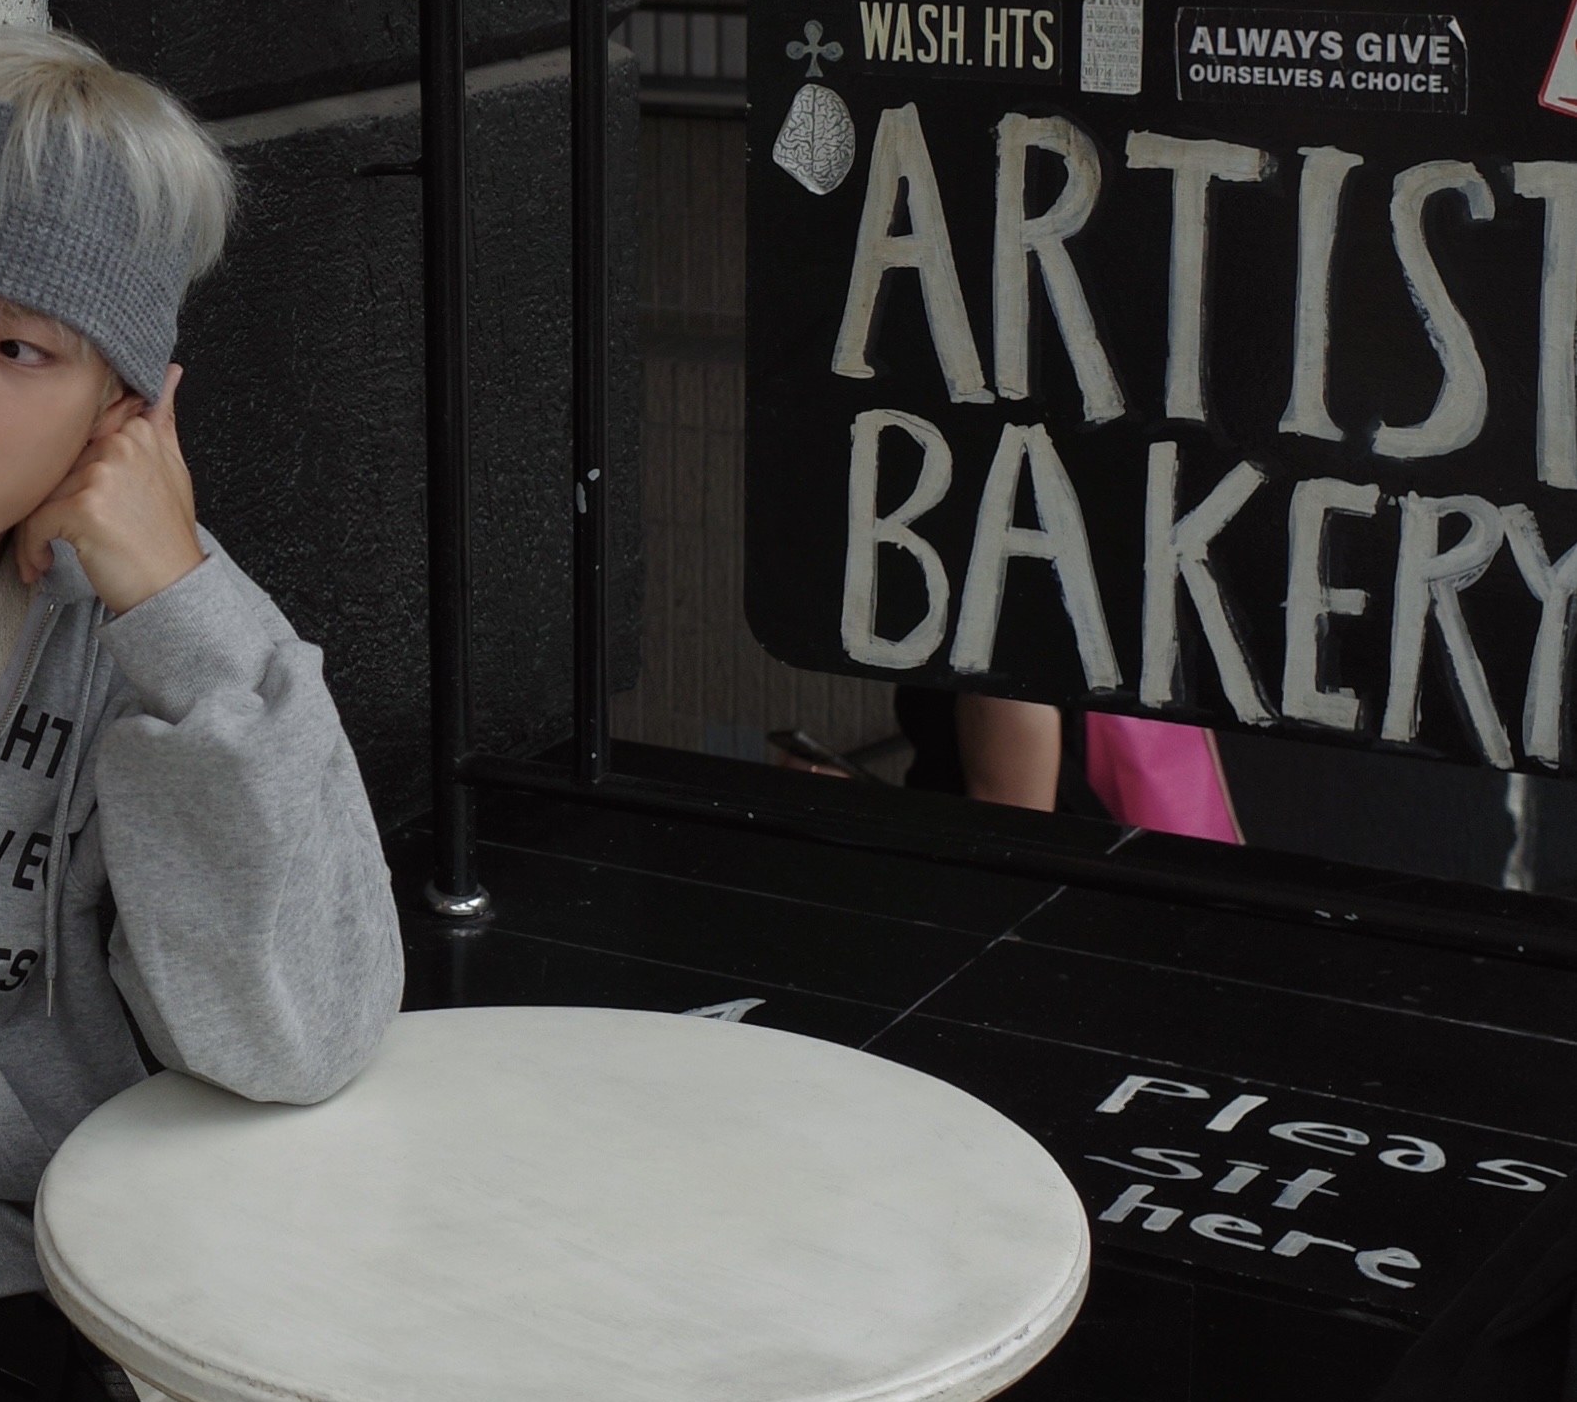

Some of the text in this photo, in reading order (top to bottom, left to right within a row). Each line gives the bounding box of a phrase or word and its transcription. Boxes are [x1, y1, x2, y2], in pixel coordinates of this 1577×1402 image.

[859, 1, 1054, 70] WASH. HTS
[1189, 26, 1451, 65] ALWAYS GIVE
[1189, 63, 1449, 93] OURSELVES A CHOICE.
[1097, 1183, 1422, 1290] here
